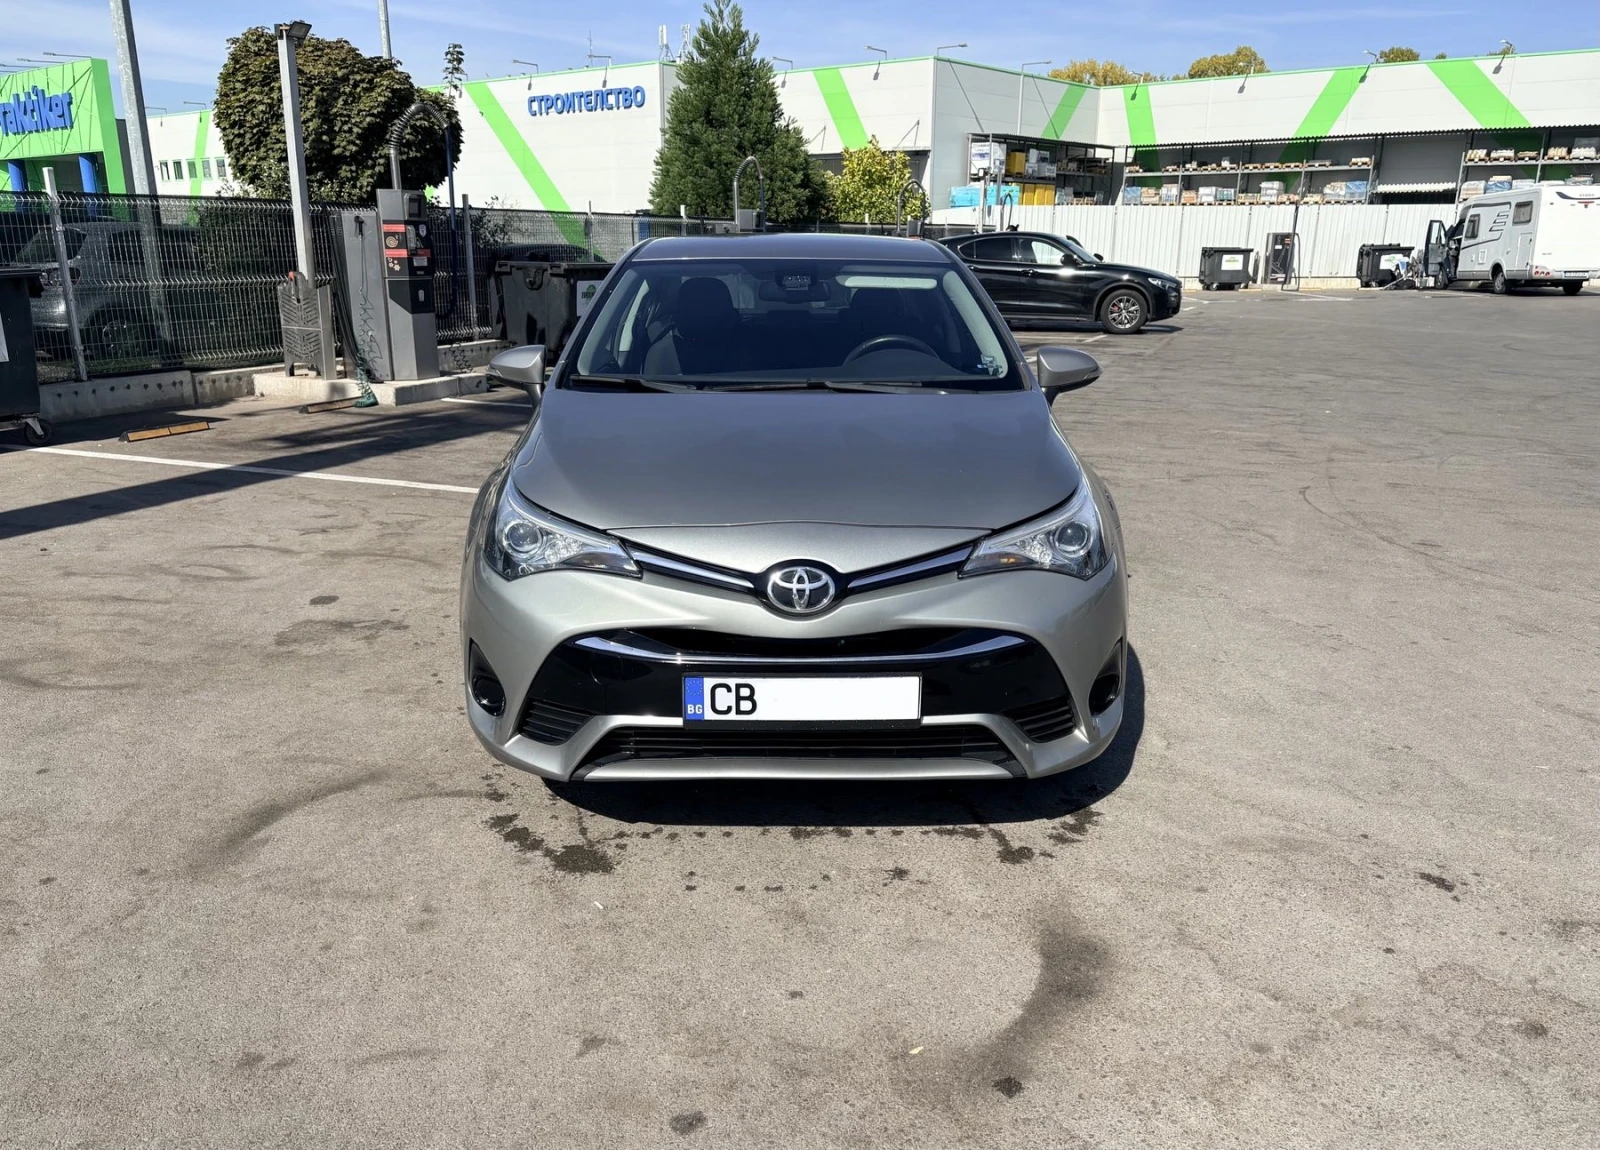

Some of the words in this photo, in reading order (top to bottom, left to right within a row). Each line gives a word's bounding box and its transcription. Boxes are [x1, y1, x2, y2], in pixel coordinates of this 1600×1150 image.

[0, 85, 73, 136] raktiker
[527, 86, 646, 117] СТРОИТЕЛСТВО
[687, 704, 703, 714] BG
[710, 683, 757, 715] CB
